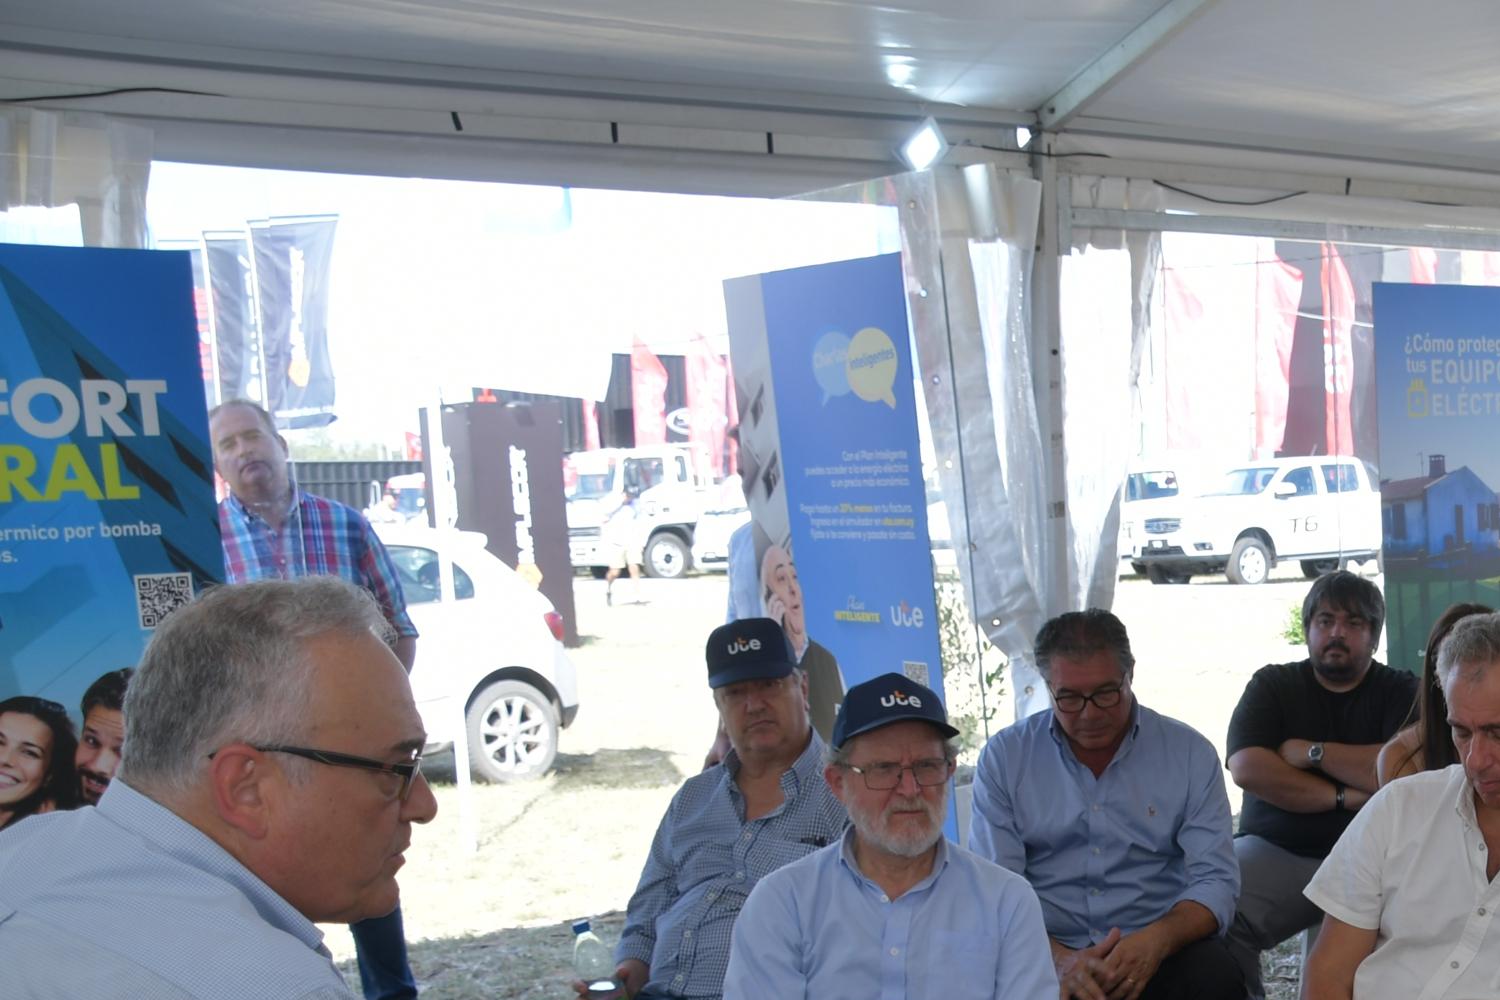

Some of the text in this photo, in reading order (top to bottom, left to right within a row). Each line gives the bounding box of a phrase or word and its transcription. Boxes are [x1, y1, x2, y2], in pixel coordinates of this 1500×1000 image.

[1404, 332, 1454, 354] ¿Cómo
[1407, 357, 1427, 373] tus
[0, 377, 168, 440] ORT
[64, 526, 95, 543] por
[101, 520, 162, 538] bomba
[890, 599, 924, 628] ute
[727, 636, 762, 655] ute
[880, 690, 922, 708] ute
